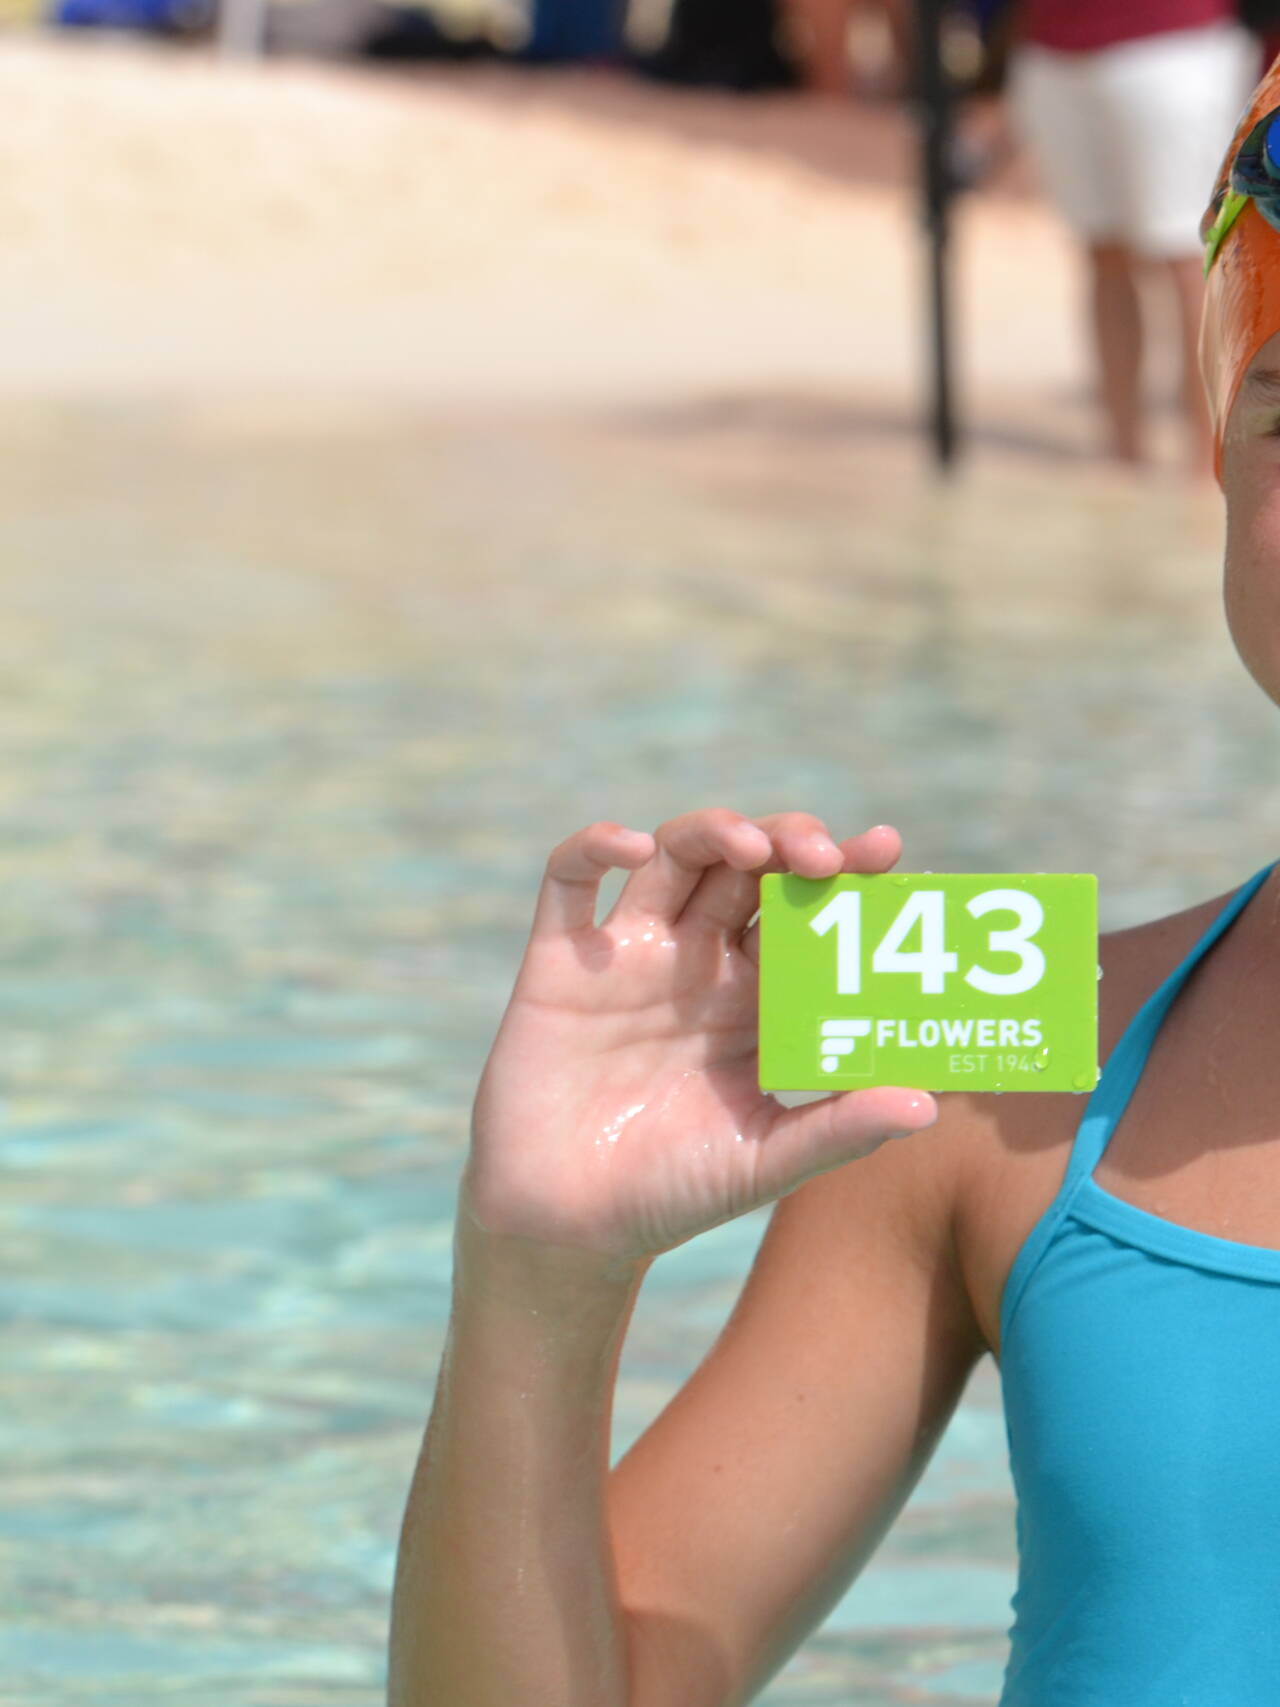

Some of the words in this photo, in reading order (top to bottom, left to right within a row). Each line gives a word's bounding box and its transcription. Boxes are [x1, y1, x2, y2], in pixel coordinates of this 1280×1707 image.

[809, 889, 1046, 995] 143
[877, 1019, 1043, 1048] FLOWERS
[949, 1055, 987, 1073] EST
